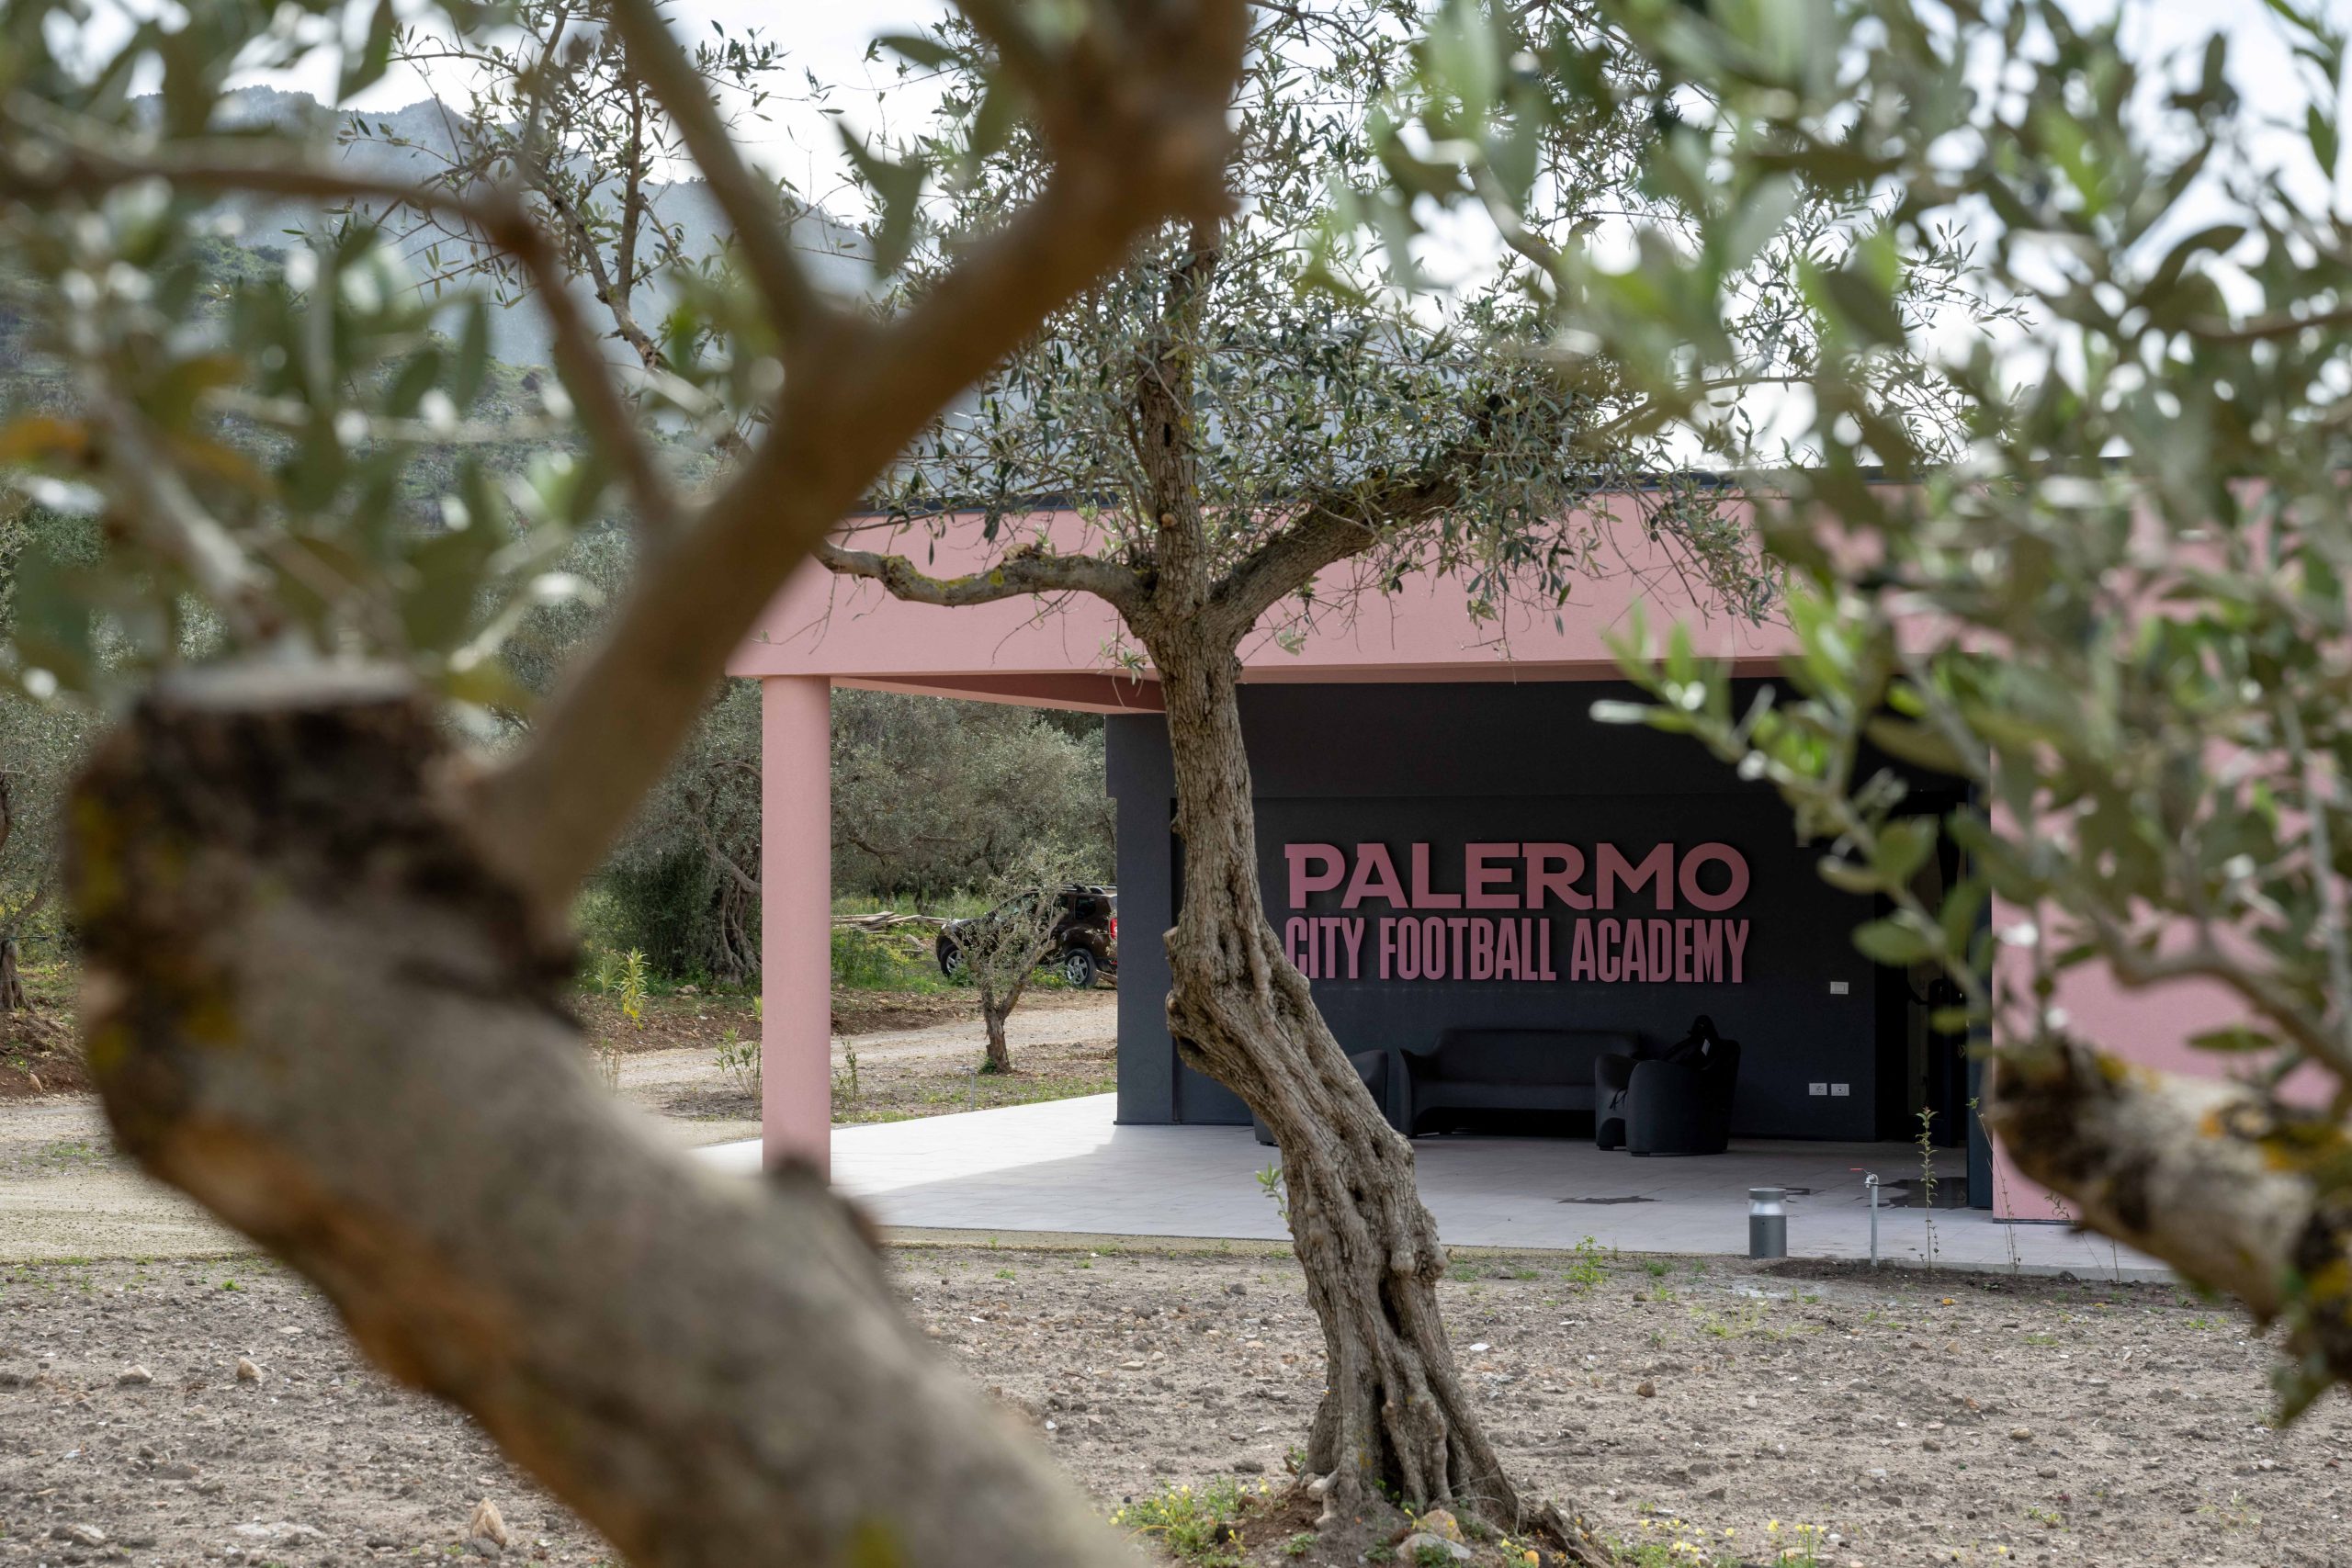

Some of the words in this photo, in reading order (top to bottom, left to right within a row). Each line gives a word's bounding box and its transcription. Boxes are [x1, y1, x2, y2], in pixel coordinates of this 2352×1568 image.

[1284, 842, 1749, 911] PALERMO
[1285, 916, 1365, 979] CITY
[1379, 916, 1556, 981] FOOTBALL
[1570, 918, 1749, 984] ACADEMY
